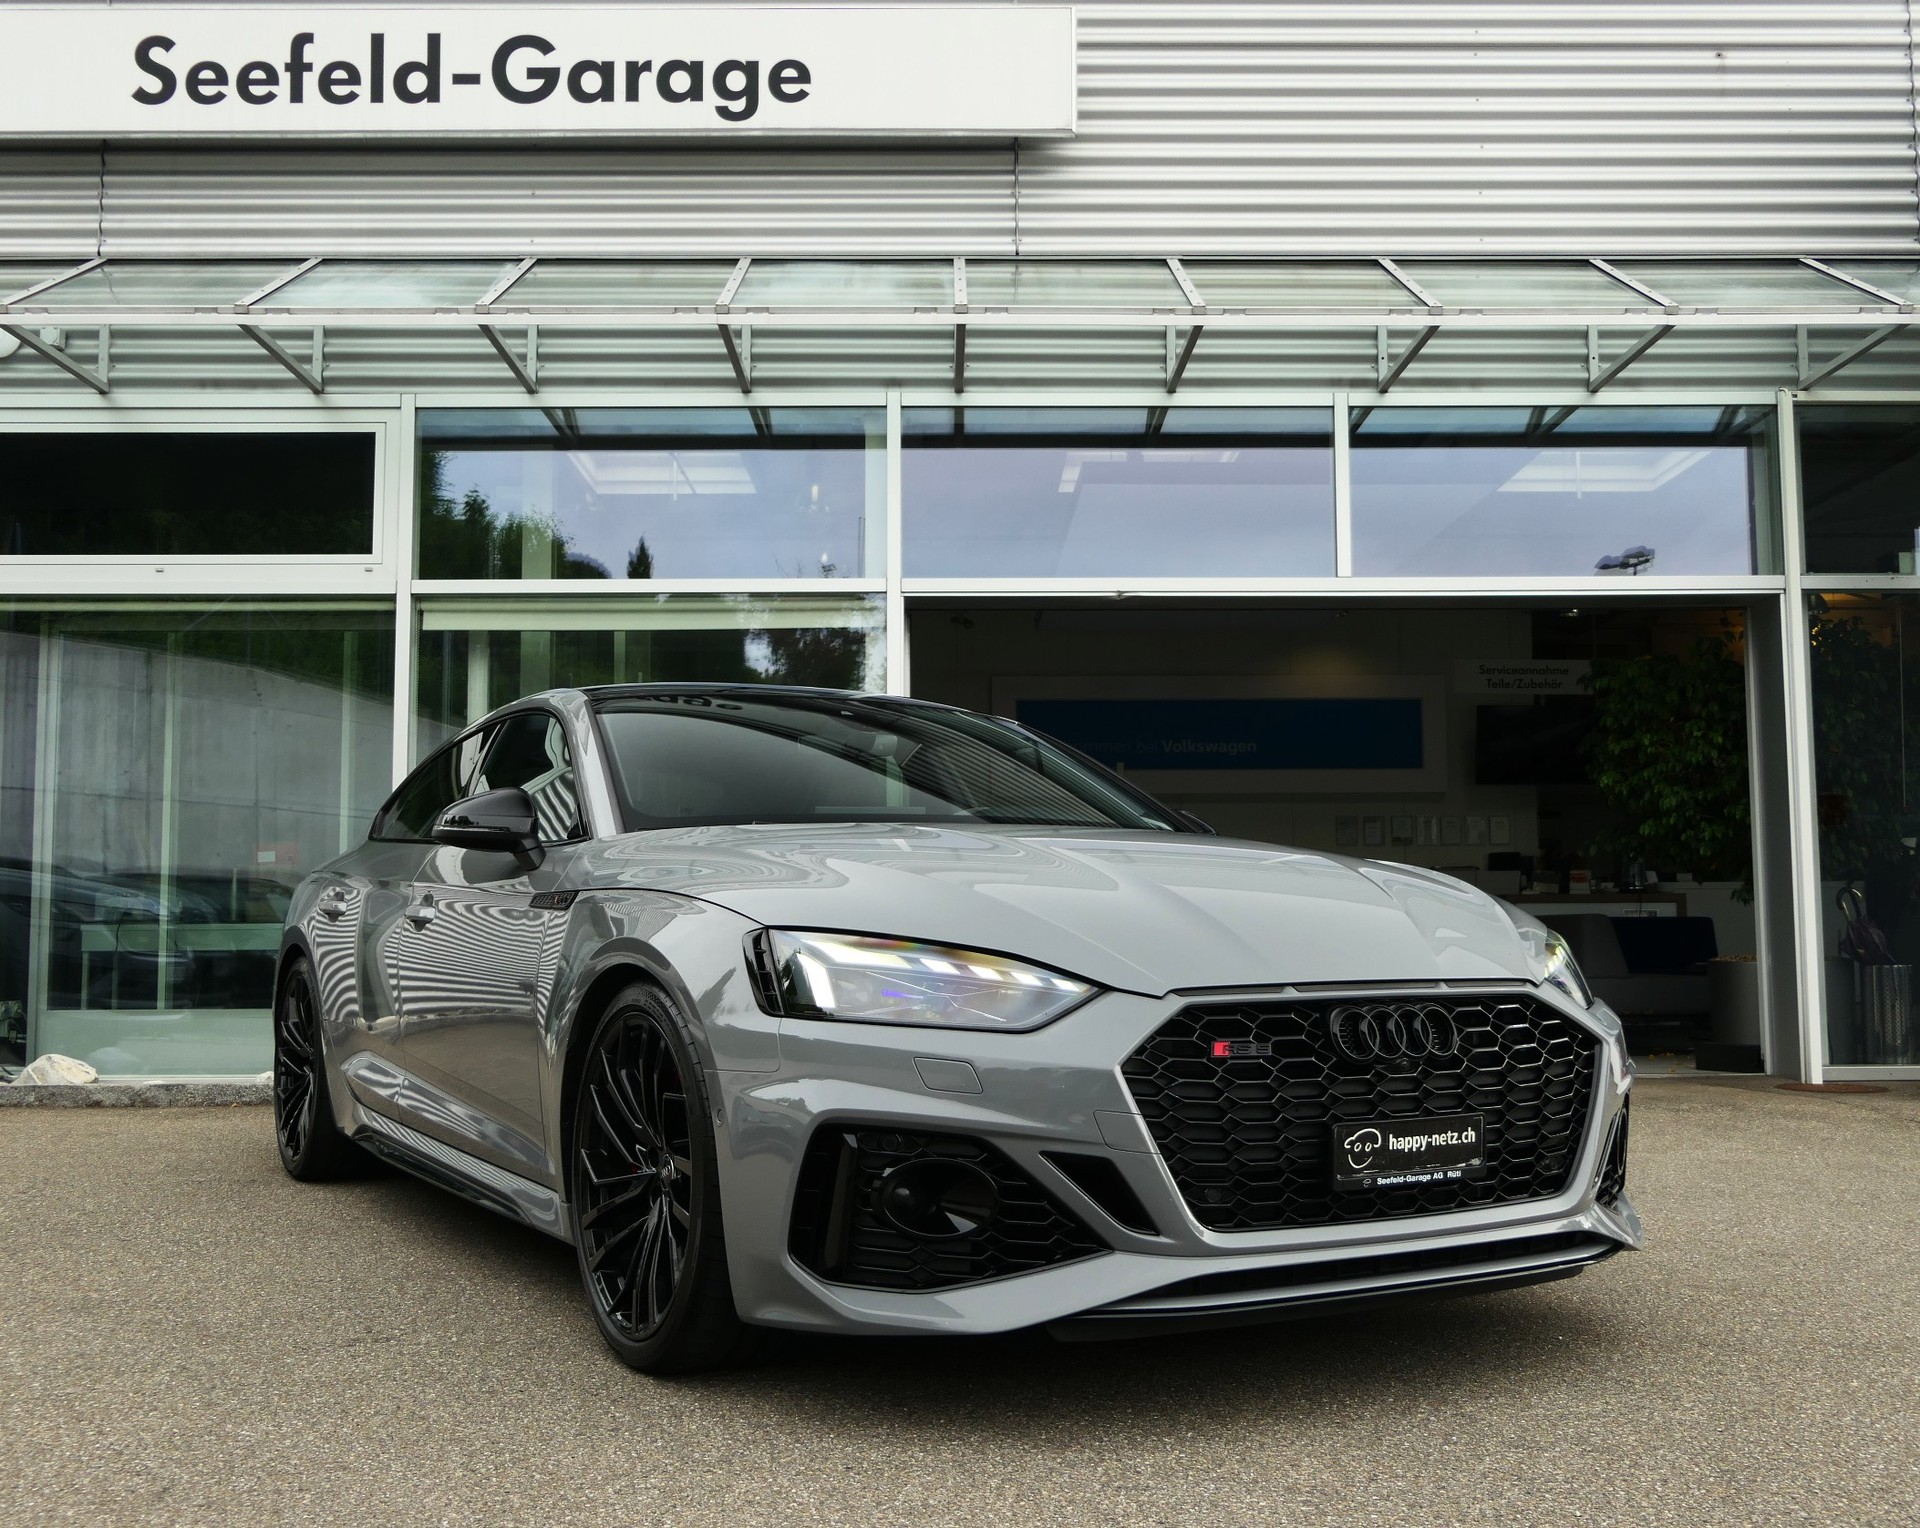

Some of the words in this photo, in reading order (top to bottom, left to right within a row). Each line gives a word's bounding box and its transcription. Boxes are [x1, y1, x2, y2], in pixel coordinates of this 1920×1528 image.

[132, 33, 811, 121] Seefeld-Garage
[1478, 664, 1569, 675] Serviceannahme
[1485, 678, 1563, 689] Teile/Zubehör
[1161, 739, 1257, 756] Volkswagen
[1388, 1126, 1476, 1153] happy-netz.ch
[1376, 1174, 1432, 1185] Seefeld-Garage
